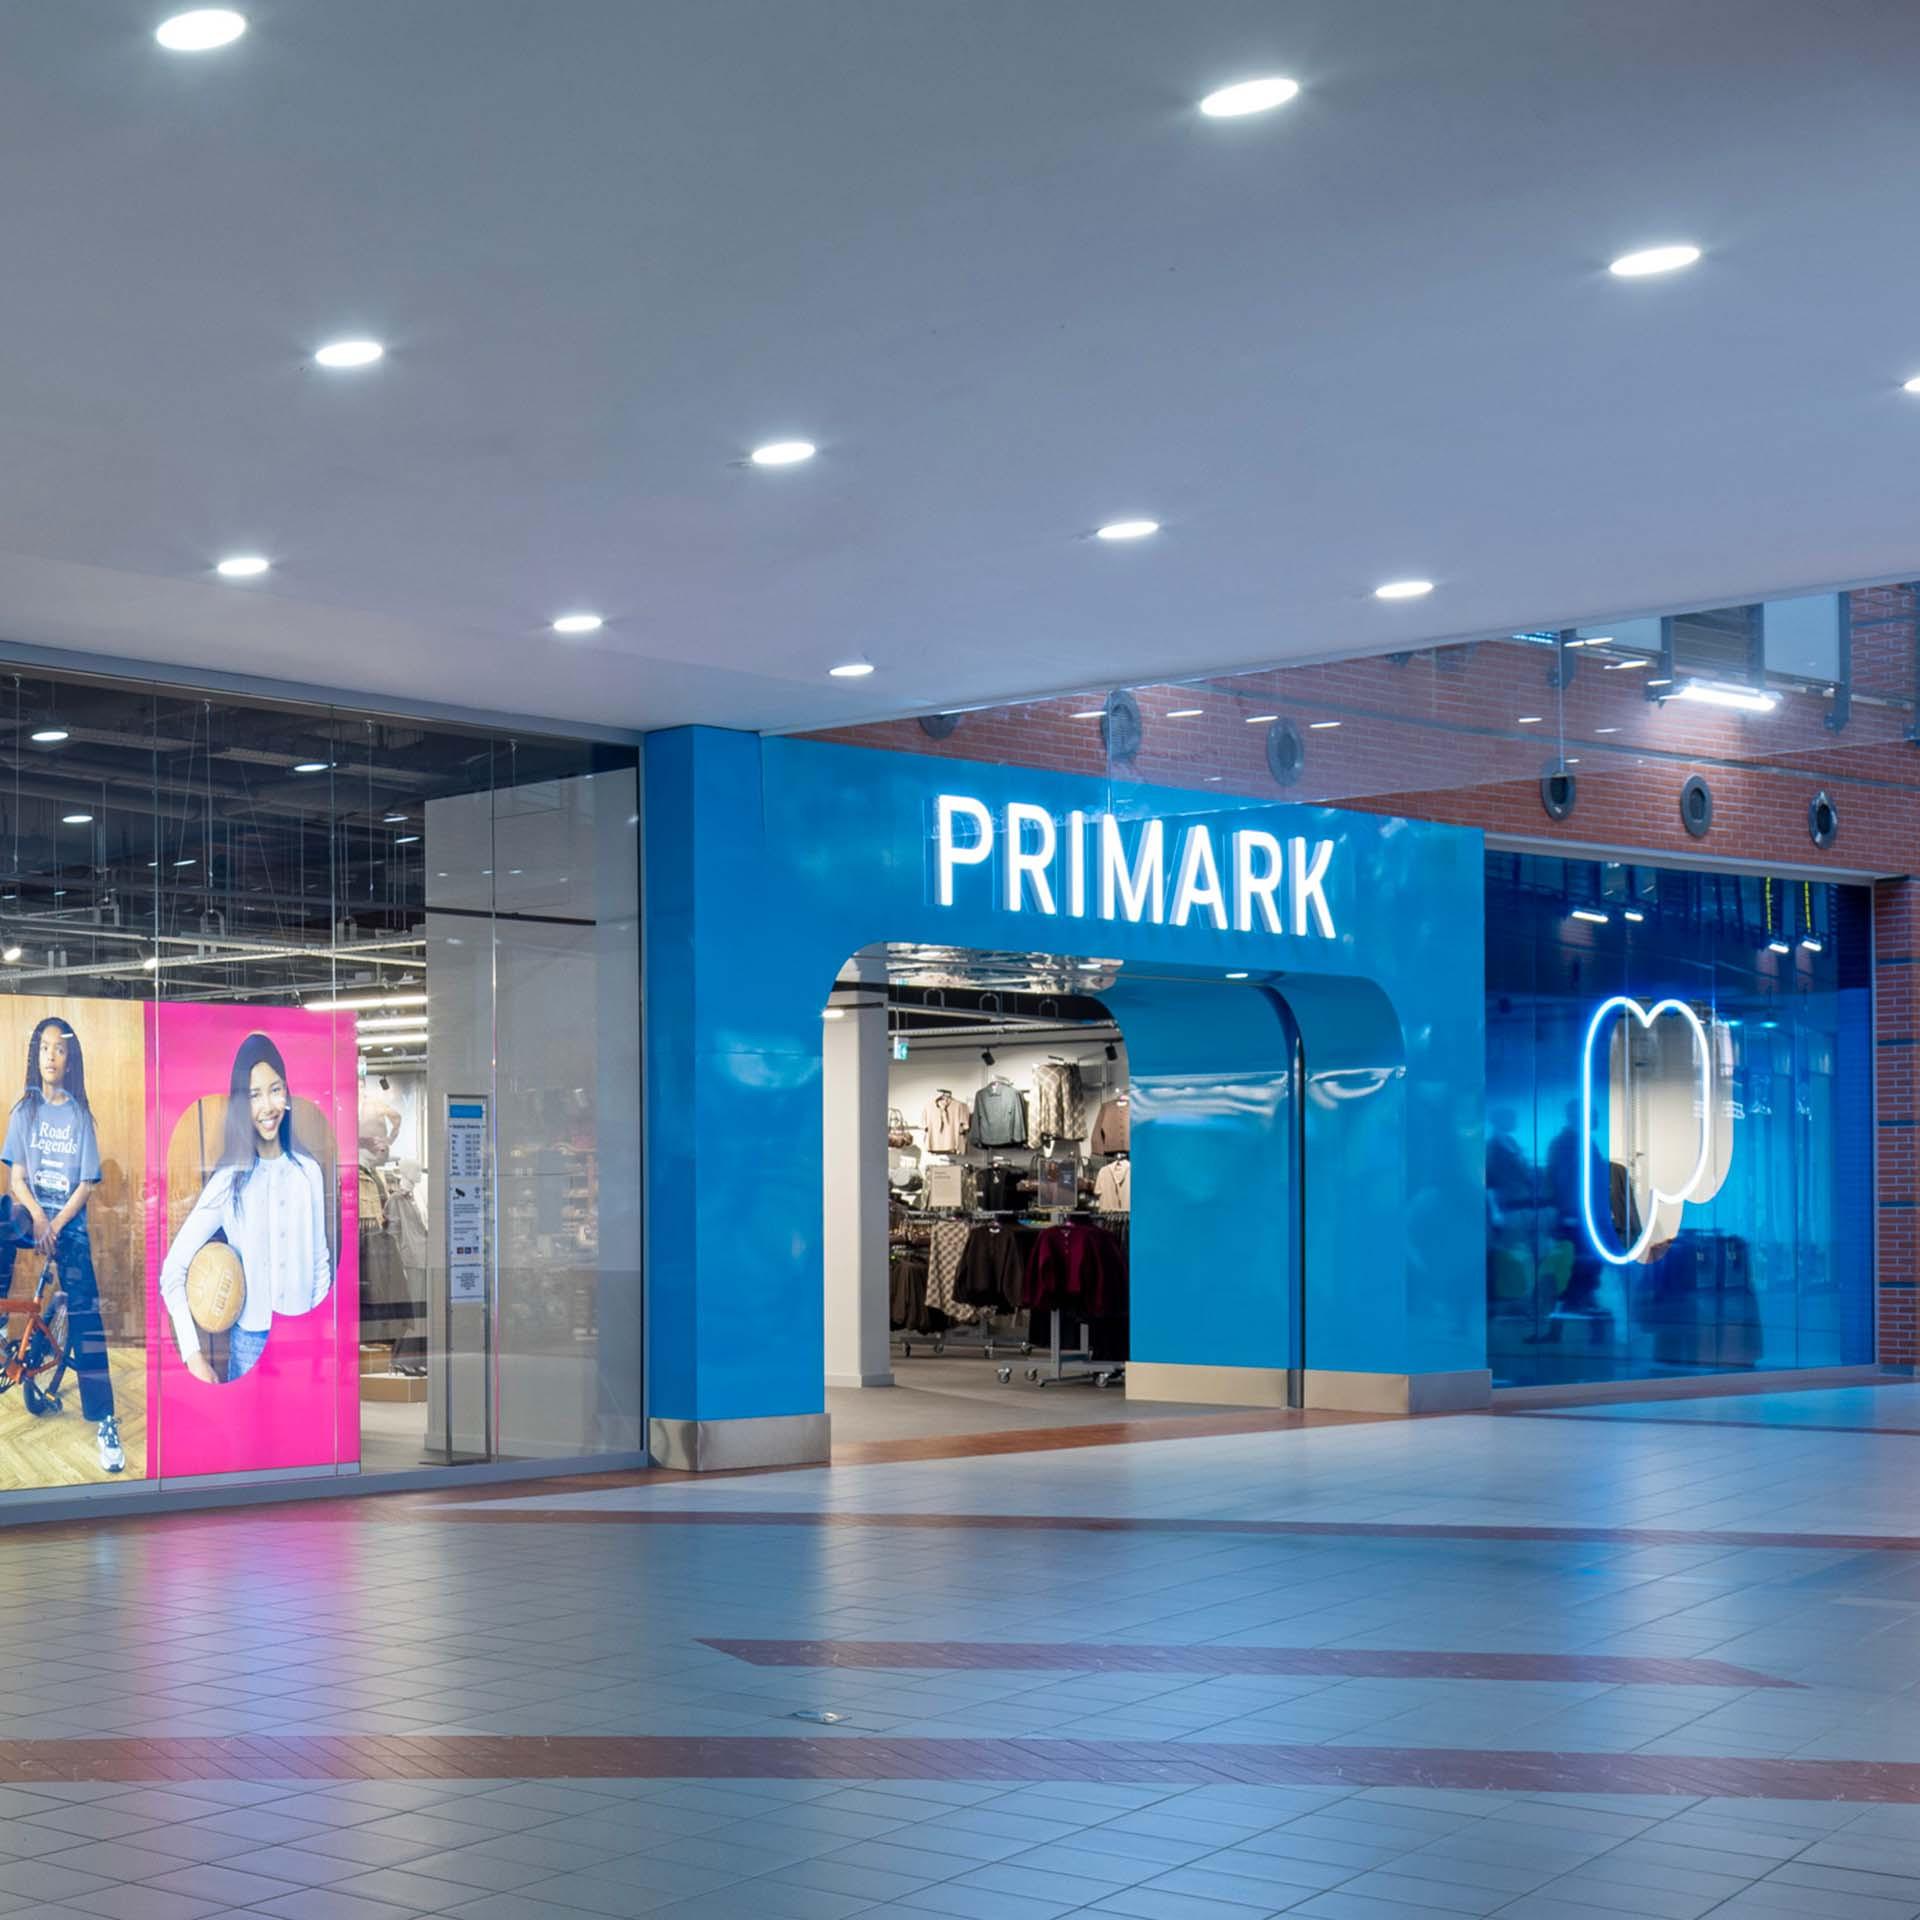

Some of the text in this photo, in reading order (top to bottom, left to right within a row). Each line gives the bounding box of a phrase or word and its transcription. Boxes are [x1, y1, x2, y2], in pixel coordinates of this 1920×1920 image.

[936, 794, 1337, 939] PRIMARK
[41, 1121, 71, 1139] Road
[31, 1132, 78, 1154] Legends
